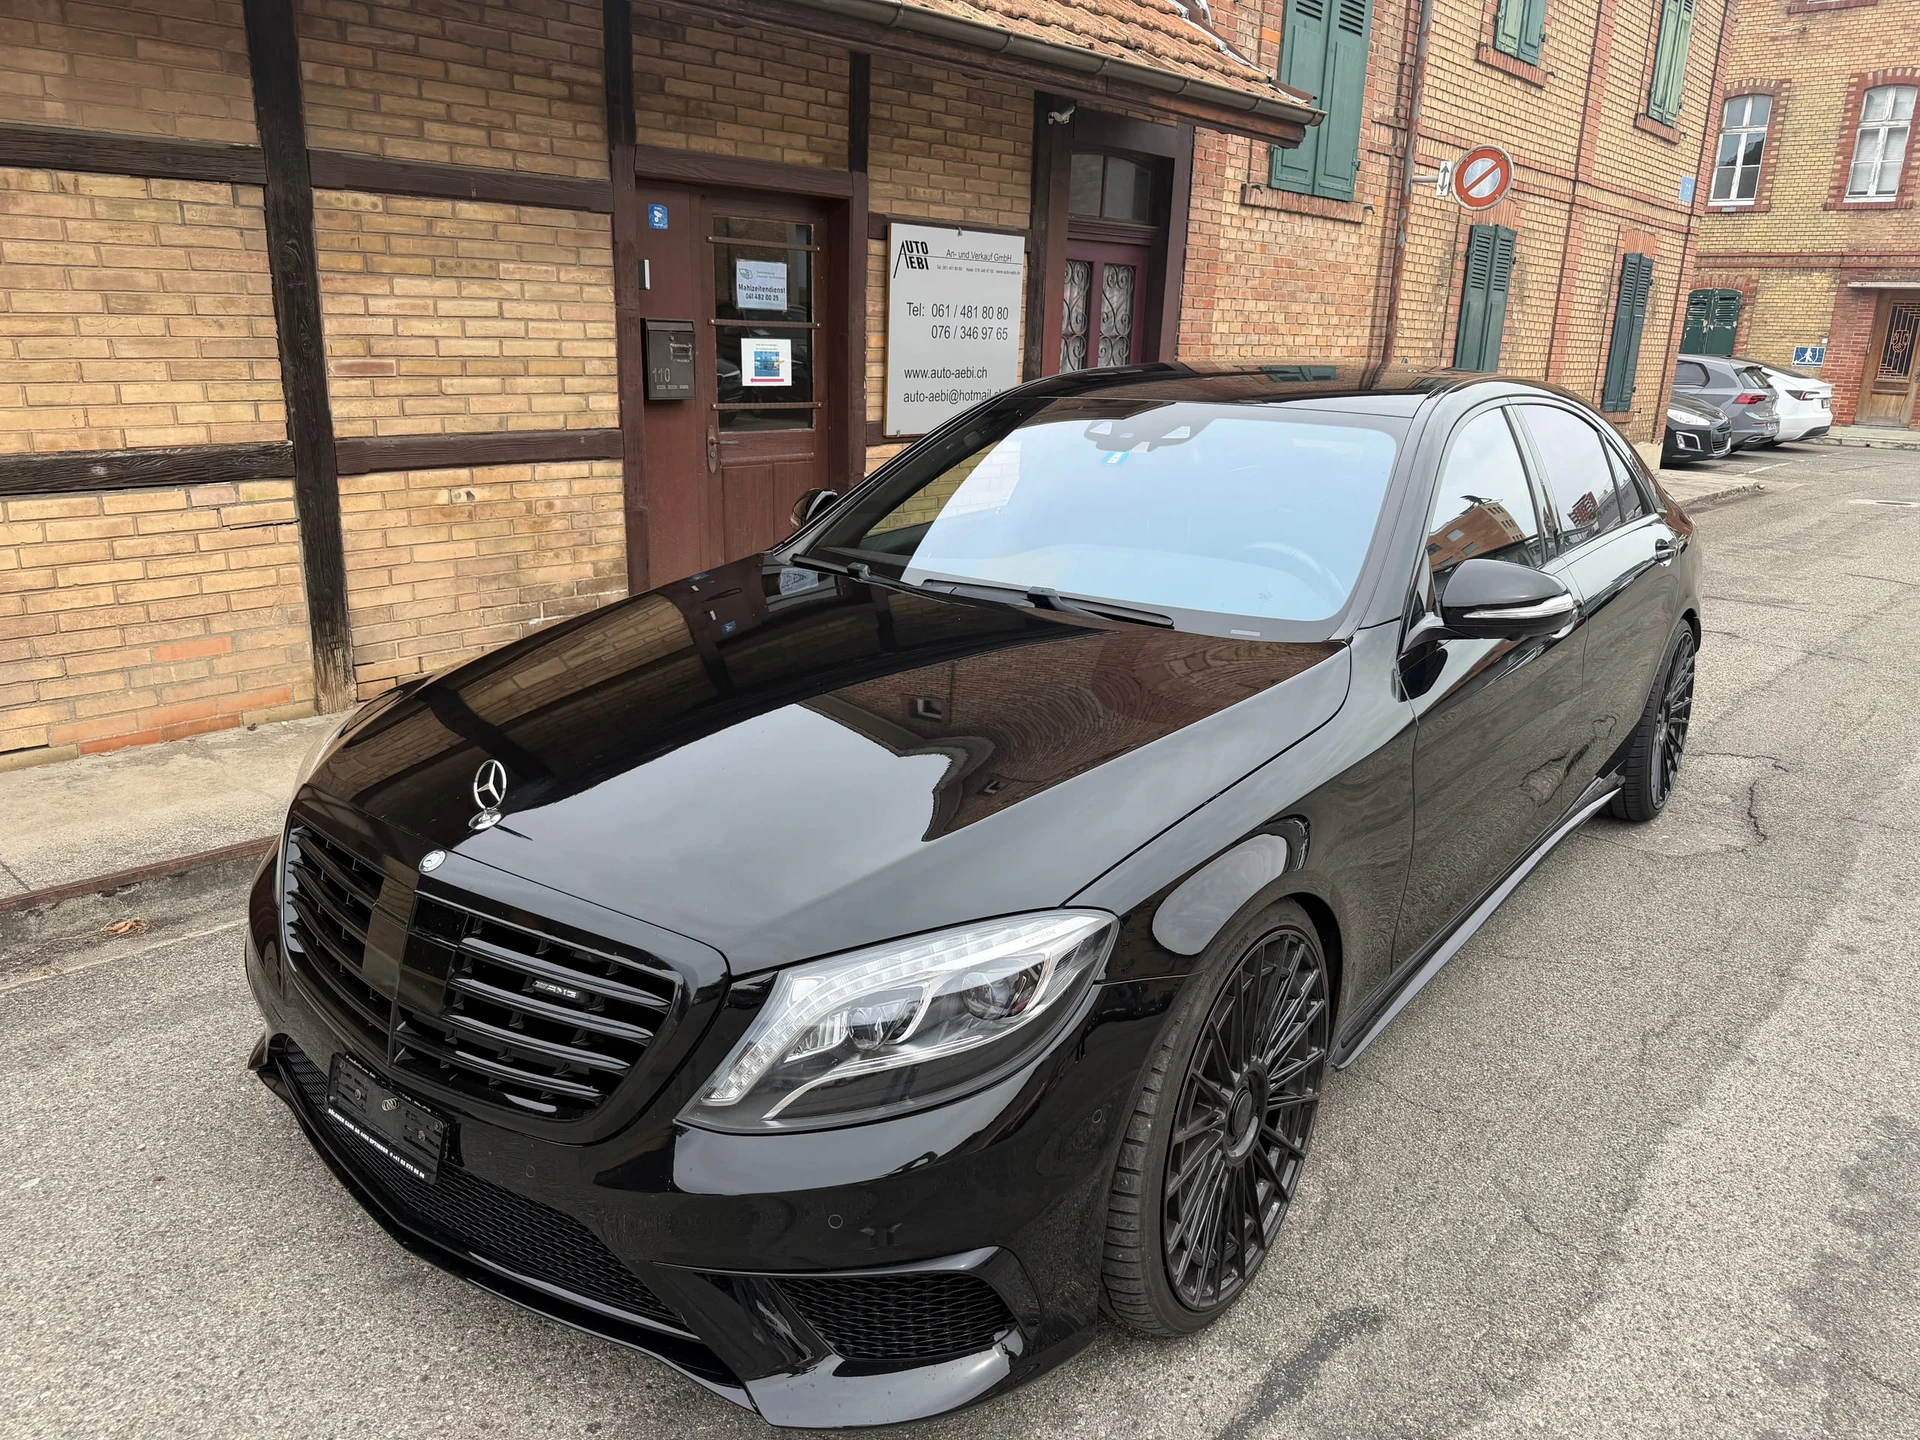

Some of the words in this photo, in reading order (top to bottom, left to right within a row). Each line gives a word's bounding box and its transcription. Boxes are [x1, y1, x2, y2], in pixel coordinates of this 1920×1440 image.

[946, 249, 957, 258] An-
[958, 251, 970, 260] und
[972, 252, 993, 262] Verkauf
[994, 253, 1012, 262] GmbH
[738, 283, 786, 294] Mahlzeitendienst
[906, 302, 925, 317] Tel:
[931, 303, 950, 318] 061
[960, 305, 978, 319] 481
[981, 306, 994, 320] 80
[996, 307, 1009, 320] 80
[931, 325, 951, 339] 076
[960, 326, 979, 340] 346
[981, 327, 994, 340] 97
[996, 327, 1009, 340] 65
[652, 367, 671, 383] 110
[904, 367, 988, 379] www.auto-aebi.ch
